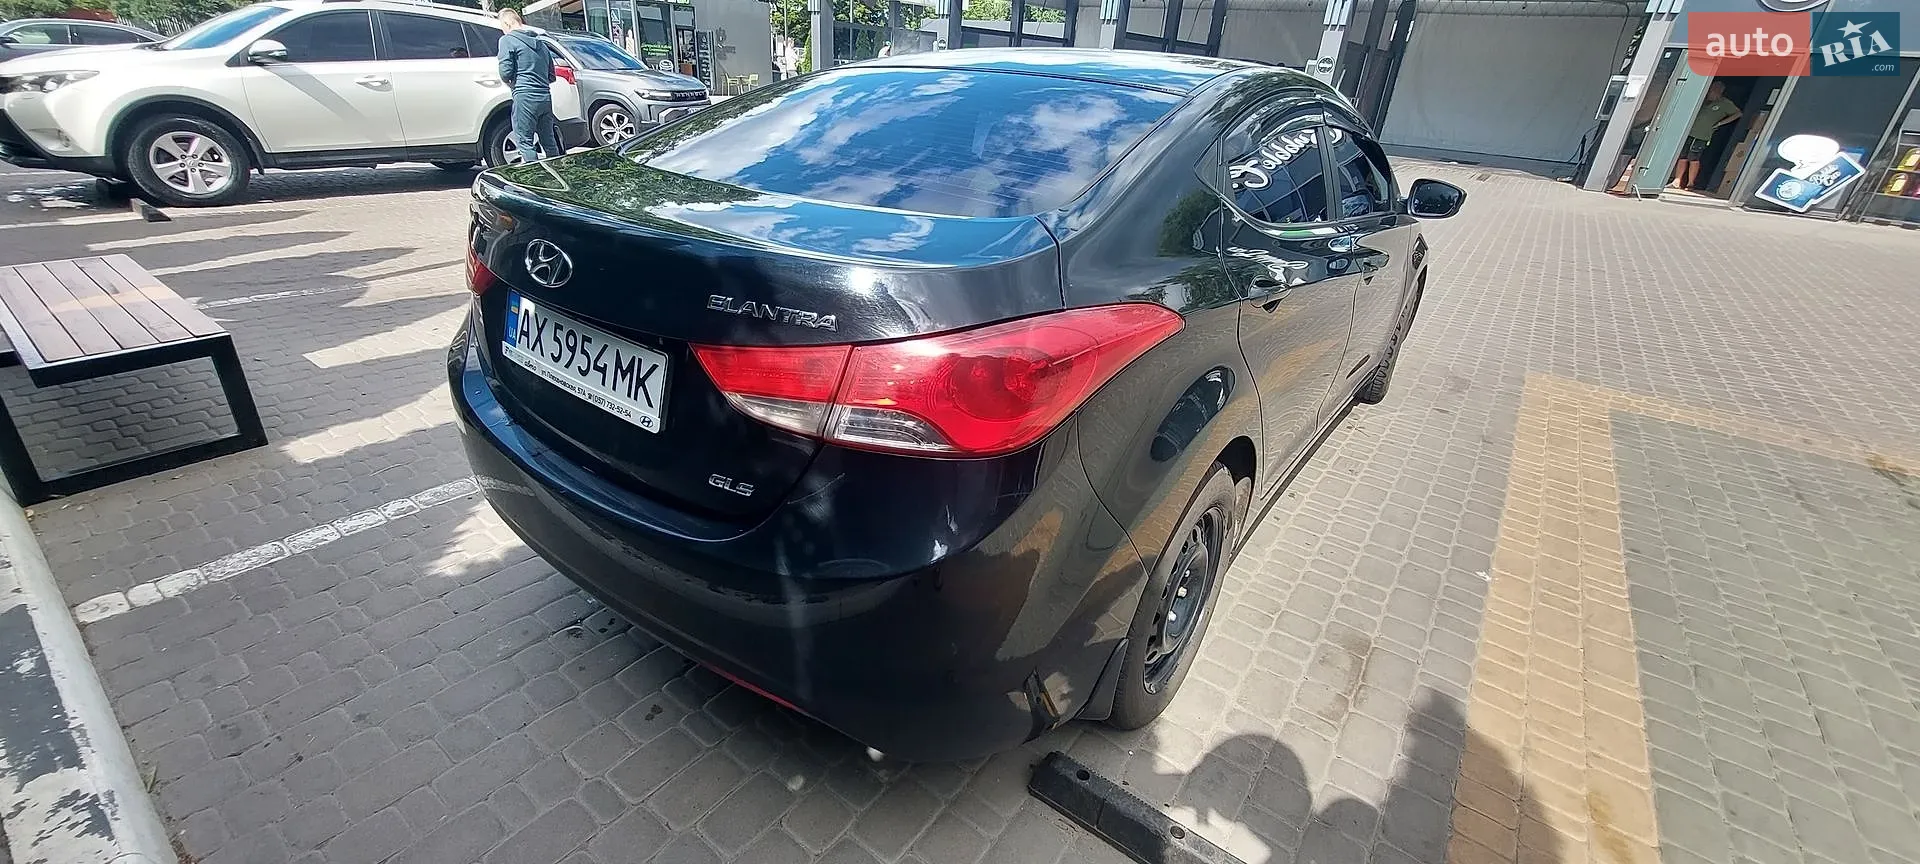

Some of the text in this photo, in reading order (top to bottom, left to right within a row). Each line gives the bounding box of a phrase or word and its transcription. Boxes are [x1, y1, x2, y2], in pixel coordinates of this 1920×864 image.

[707, 294, 838, 333] ELANTRA
[508, 326, 517, 340] UA
[518, 309, 659, 409] AX 5954 MK
[606, 399, 632, 419] 732-52-54
[708, 473, 756, 498] GLS
